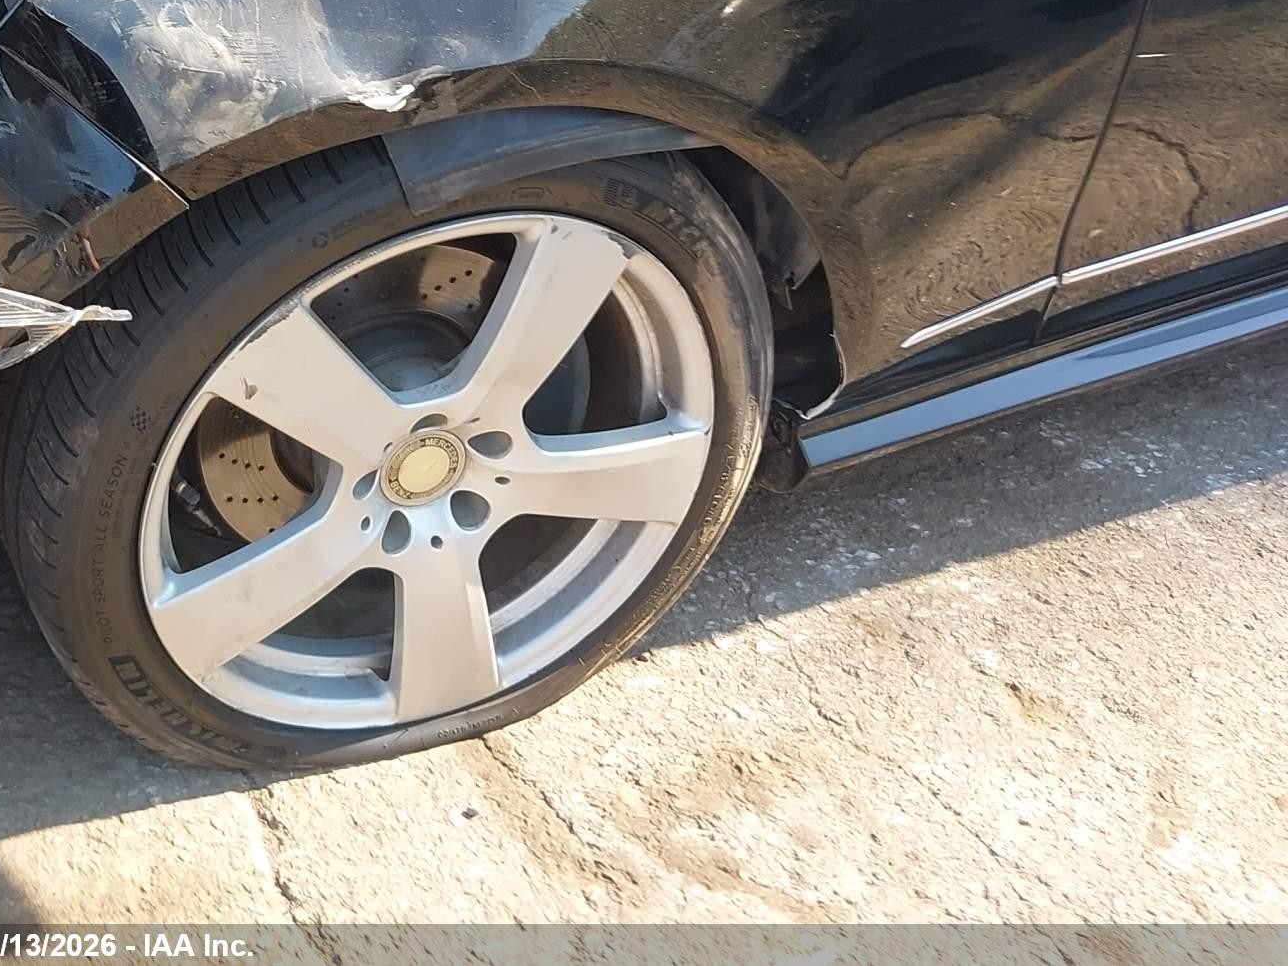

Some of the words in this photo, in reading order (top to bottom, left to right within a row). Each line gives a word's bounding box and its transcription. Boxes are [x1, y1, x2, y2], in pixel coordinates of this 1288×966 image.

[424, 438, 459, 471] MERCEDES
[98, 453, 128, 519] SEASON
[390, 480, 414, 499] BENZ
[93, 525, 108, 552] ALL
[91, 559, 107, 603] SPORT
[95, 610, 114, 644] PILOT
